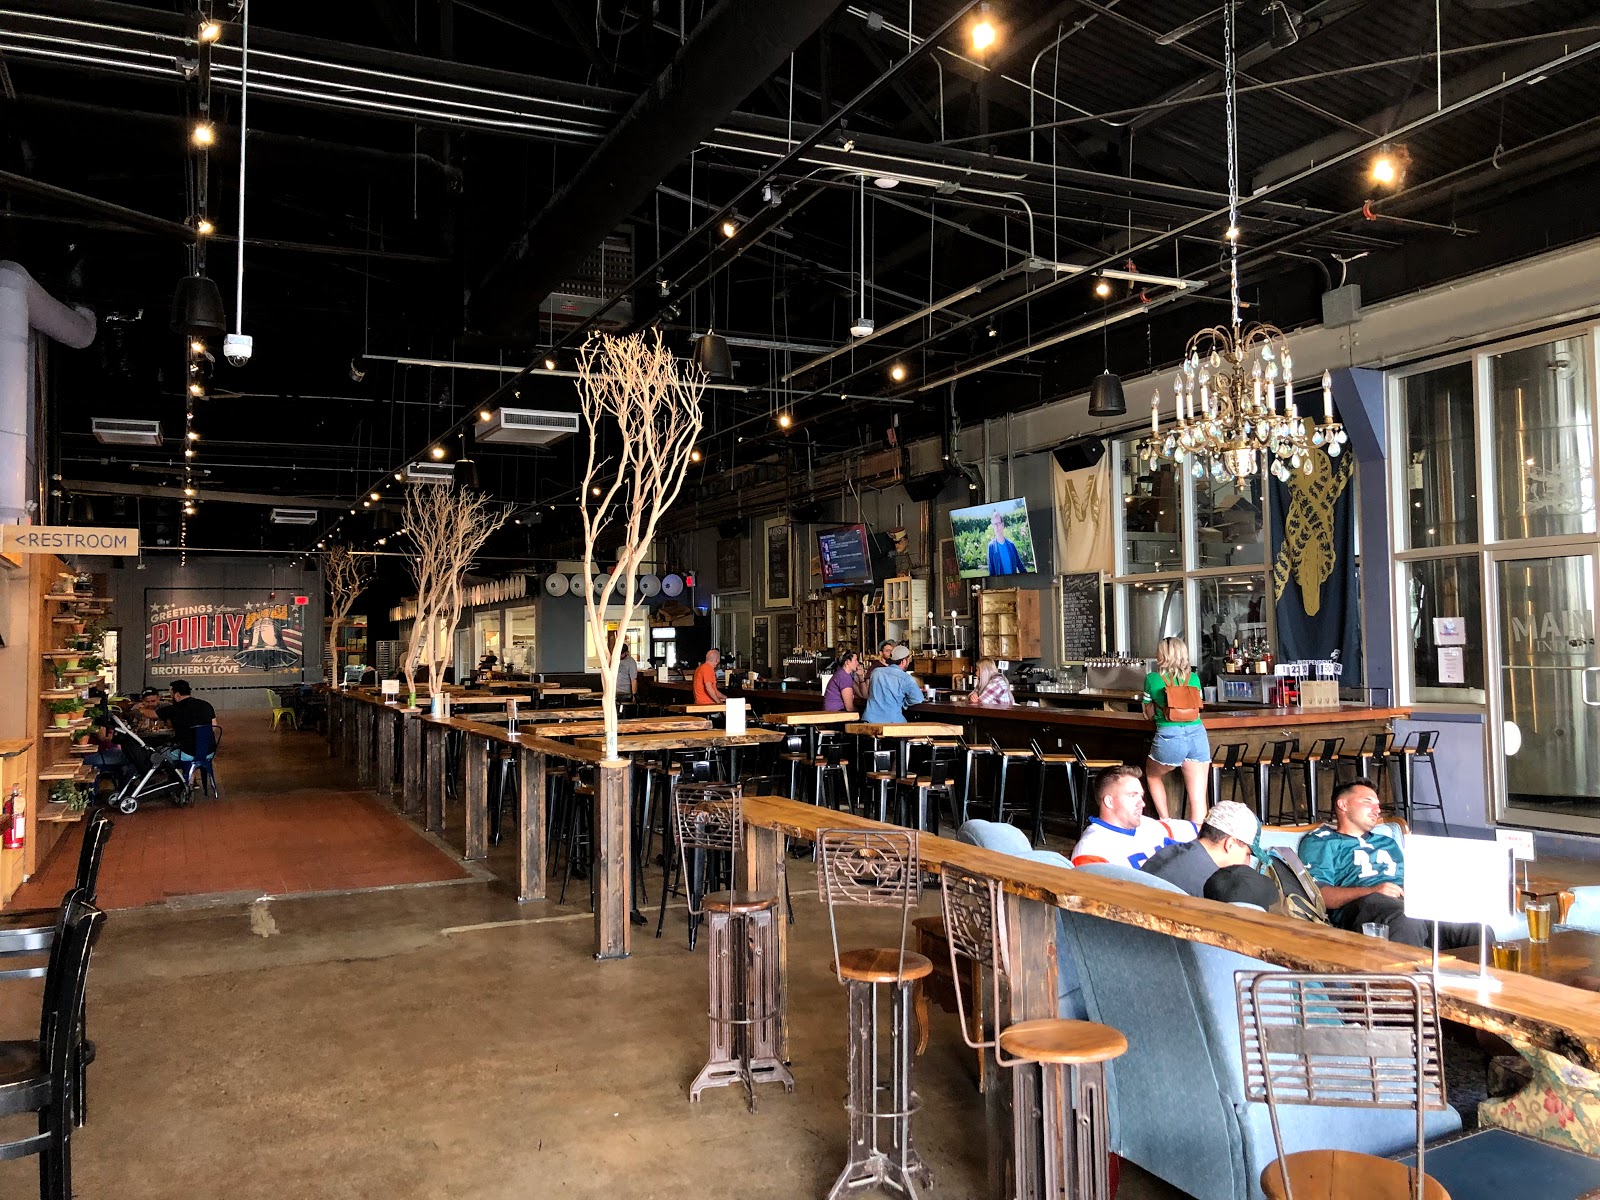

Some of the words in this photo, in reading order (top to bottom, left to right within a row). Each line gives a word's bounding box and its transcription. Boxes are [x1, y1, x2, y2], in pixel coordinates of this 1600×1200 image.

[28, 532, 127, 549] RESTROOM
[150, 604, 213, 623] GREETINGS
[1512, 609, 1593, 642] MAIN
[151, 614, 244, 659] PHILLY
[151, 665, 211, 675] BROTHERLY
[213, 665, 239, 674] LOVE
